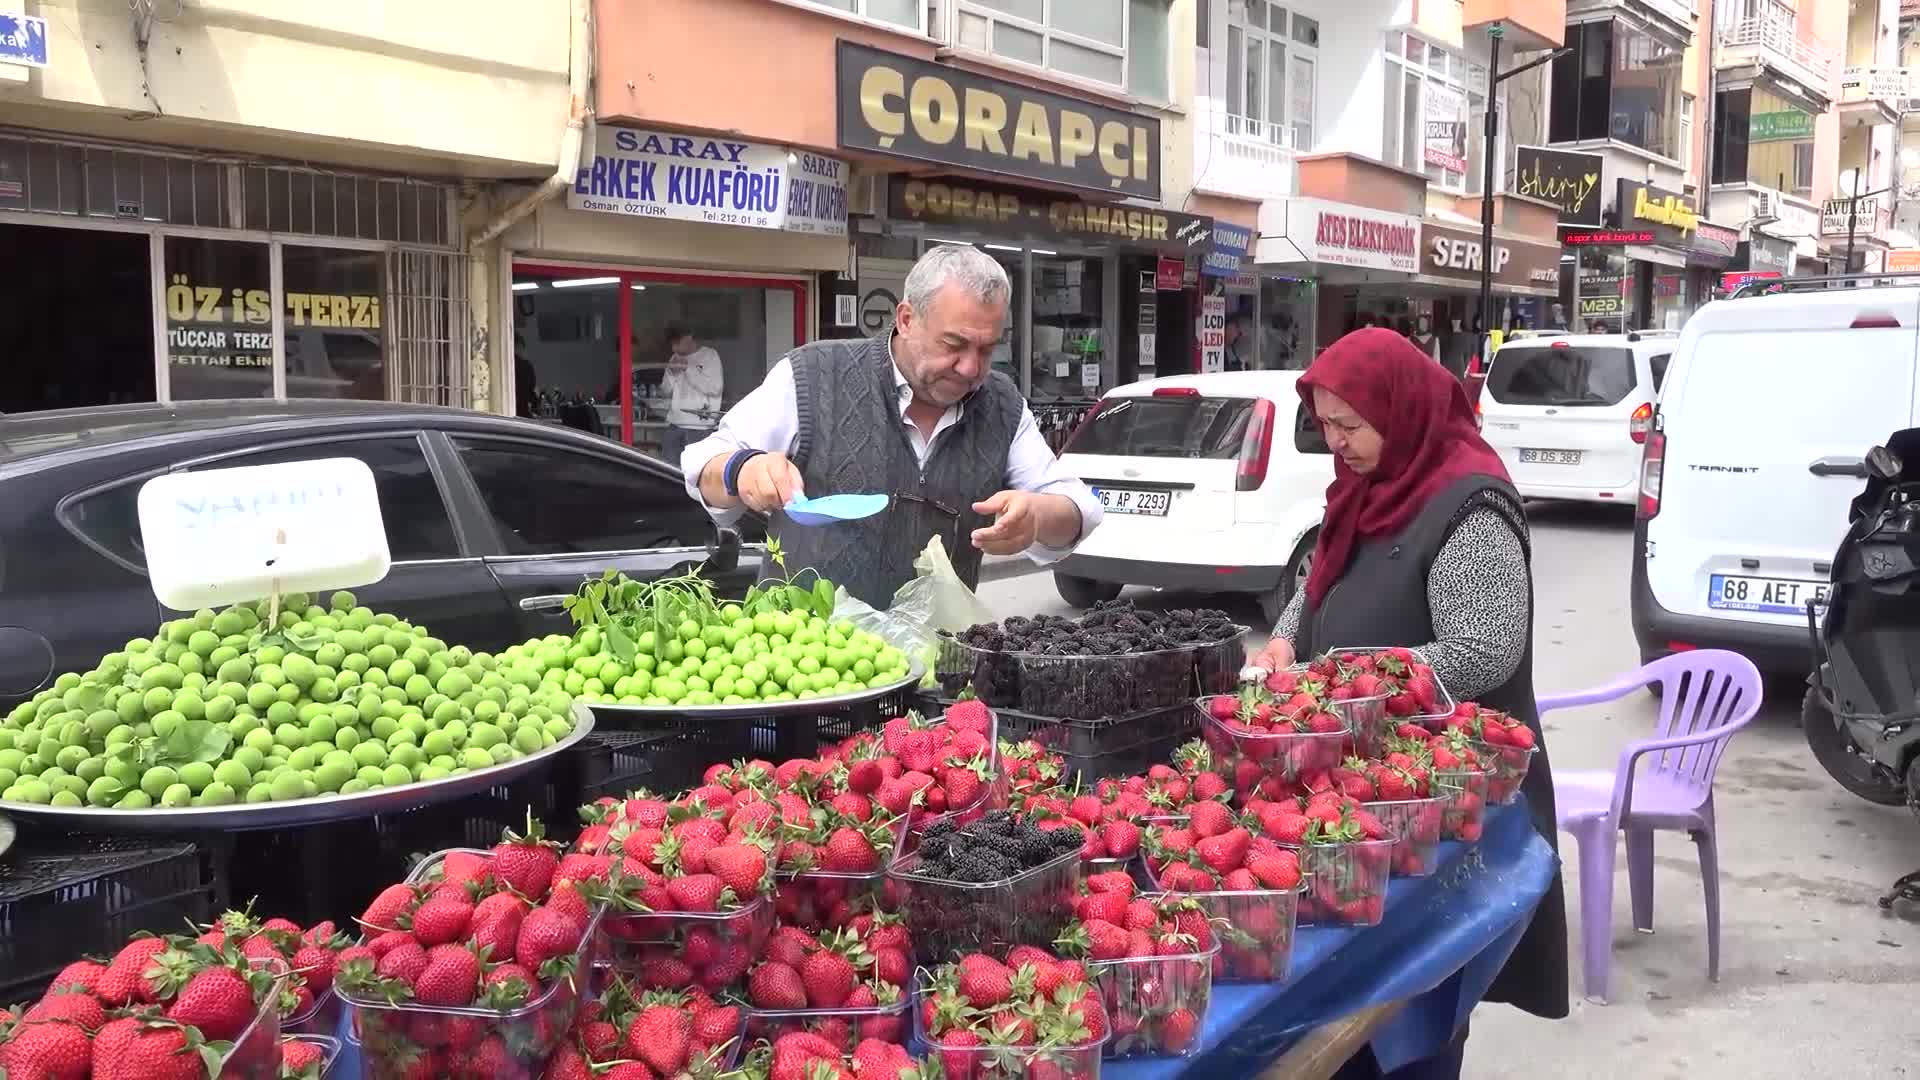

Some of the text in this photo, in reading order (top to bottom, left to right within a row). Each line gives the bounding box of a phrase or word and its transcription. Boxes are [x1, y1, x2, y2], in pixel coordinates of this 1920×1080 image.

[860, 65, 1148, 188] ÇORAPÇI
[616, 131, 748, 163] SARAY
[802, 154, 841, 180] SARAY
[575, 156, 780, 213] ERKEK KUAFÖRÜ
[787, 178, 814, 219] ERKEK
[1825, 199, 1876, 216] AVUAT
[583, 200, 667, 217] Osman ÖZTÜRK
[904, 180, 1019, 224] ÇORAP
[1049, 200, 1169, 241] ÇAMAŞIR
[741, 215, 752, 225] 01
[167, 273, 223, 323] ÖZ
[1204, 315, 1224, 329] LCD
[168, 327, 226, 348] TÜCCAR
[1204, 333, 1223, 347] LED
[168, 354, 230, 366] FETTAH
[1206, 352, 1220, 365] TV
[1524, 451, 1578, 464] 68 DS 383
[1688, 464, 1760, 474] TRANSIT
[1116, 492, 1131, 508] AP
[1137, 493, 1166, 510] 2293
[1724, 579, 1749, 601] 68
[1762, 582, 1801, 605] AET
